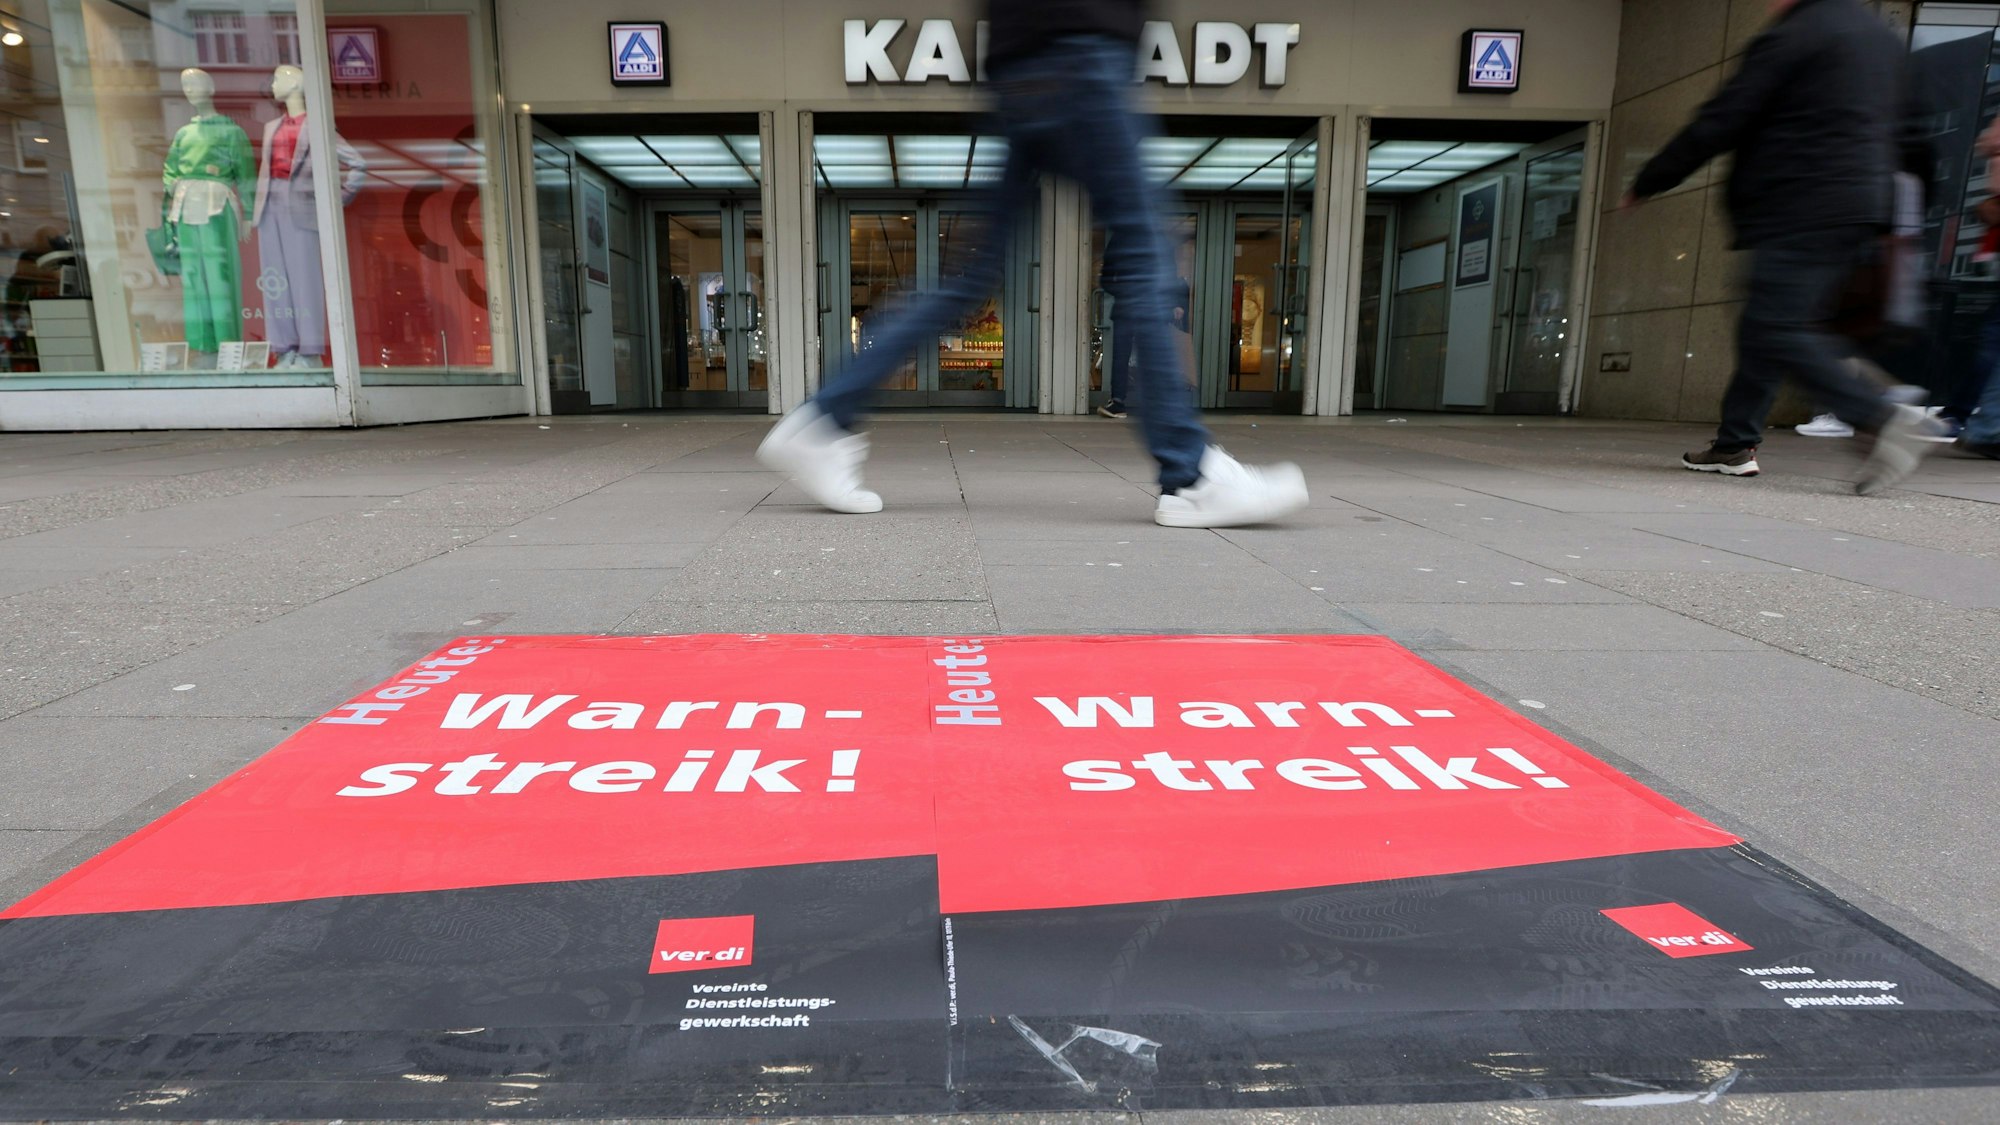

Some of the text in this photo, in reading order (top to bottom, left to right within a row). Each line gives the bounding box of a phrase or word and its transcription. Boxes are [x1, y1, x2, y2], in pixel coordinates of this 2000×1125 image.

[843, 19, 1300, 86] KAADT
[623, 64, 654, 73] ALDI
[1478, 70, 1508, 80] ALDI
[241, 307, 311, 319] GALERIA
[316, 639, 506, 725] Heute:
[933, 639, 1002, 725] Heute:
[440, 693, 863, 729] Warn-
[1033, 696, 1456, 728] Warn-
[336, 749, 862, 797] streik!
[1062, 746, 1571, 791] streik!
[1648, 931, 1734, 947] ver.di
[660, 947, 745, 961] ver.di
[1739, 966, 1815, 976] Vereinte
[692, 983, 768, 994] Vereinte
[1760, 979, 1898, 991] Dienstleistungs-
[685, 997, 836, 1010] Dienstleistungs-
[1783, 994, 1905, 1009] gewerkschaft
[679, 1014, 810, 1031] gewerkschaft
